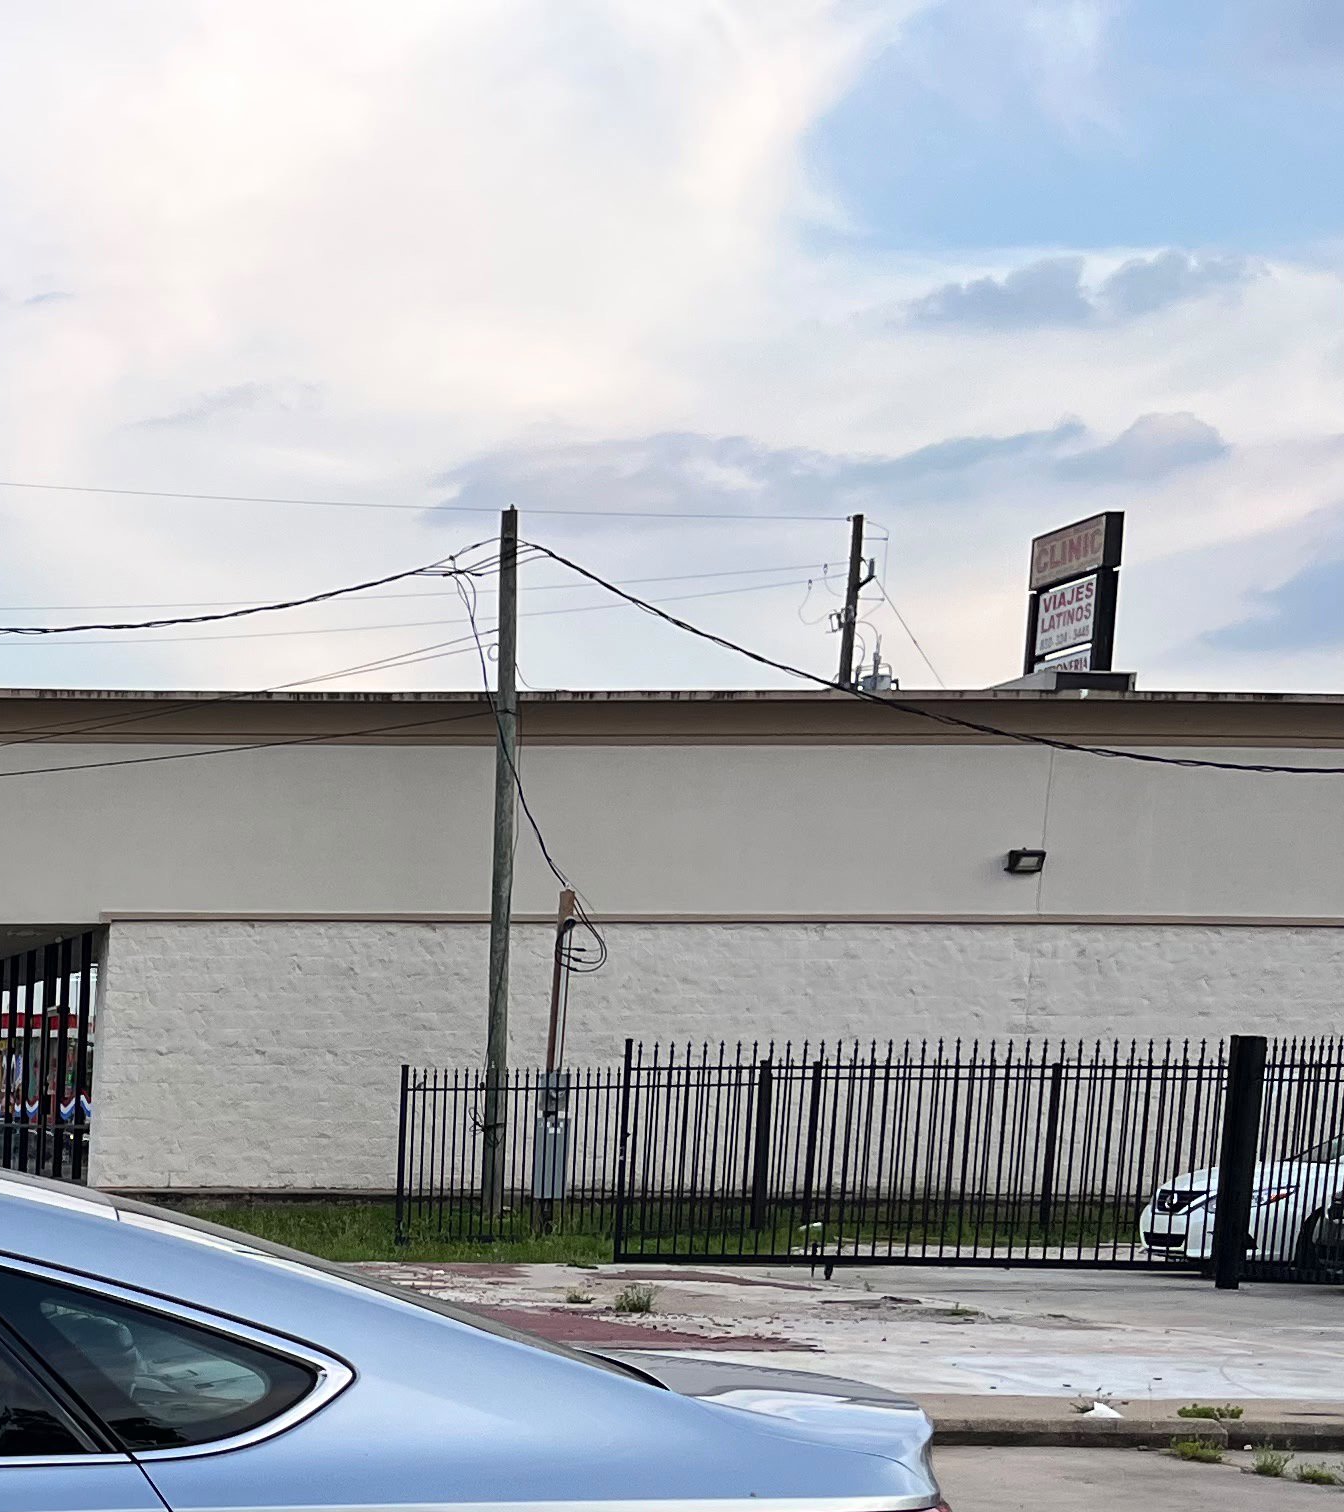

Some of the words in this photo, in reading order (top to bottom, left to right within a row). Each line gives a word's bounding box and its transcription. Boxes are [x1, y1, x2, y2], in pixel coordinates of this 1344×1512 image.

[1035, 528, 1103, 574] CLINIC
[1043, 582, 1094, 613] VIAJES
[1041, 603, 1093, 634] LATINOS
